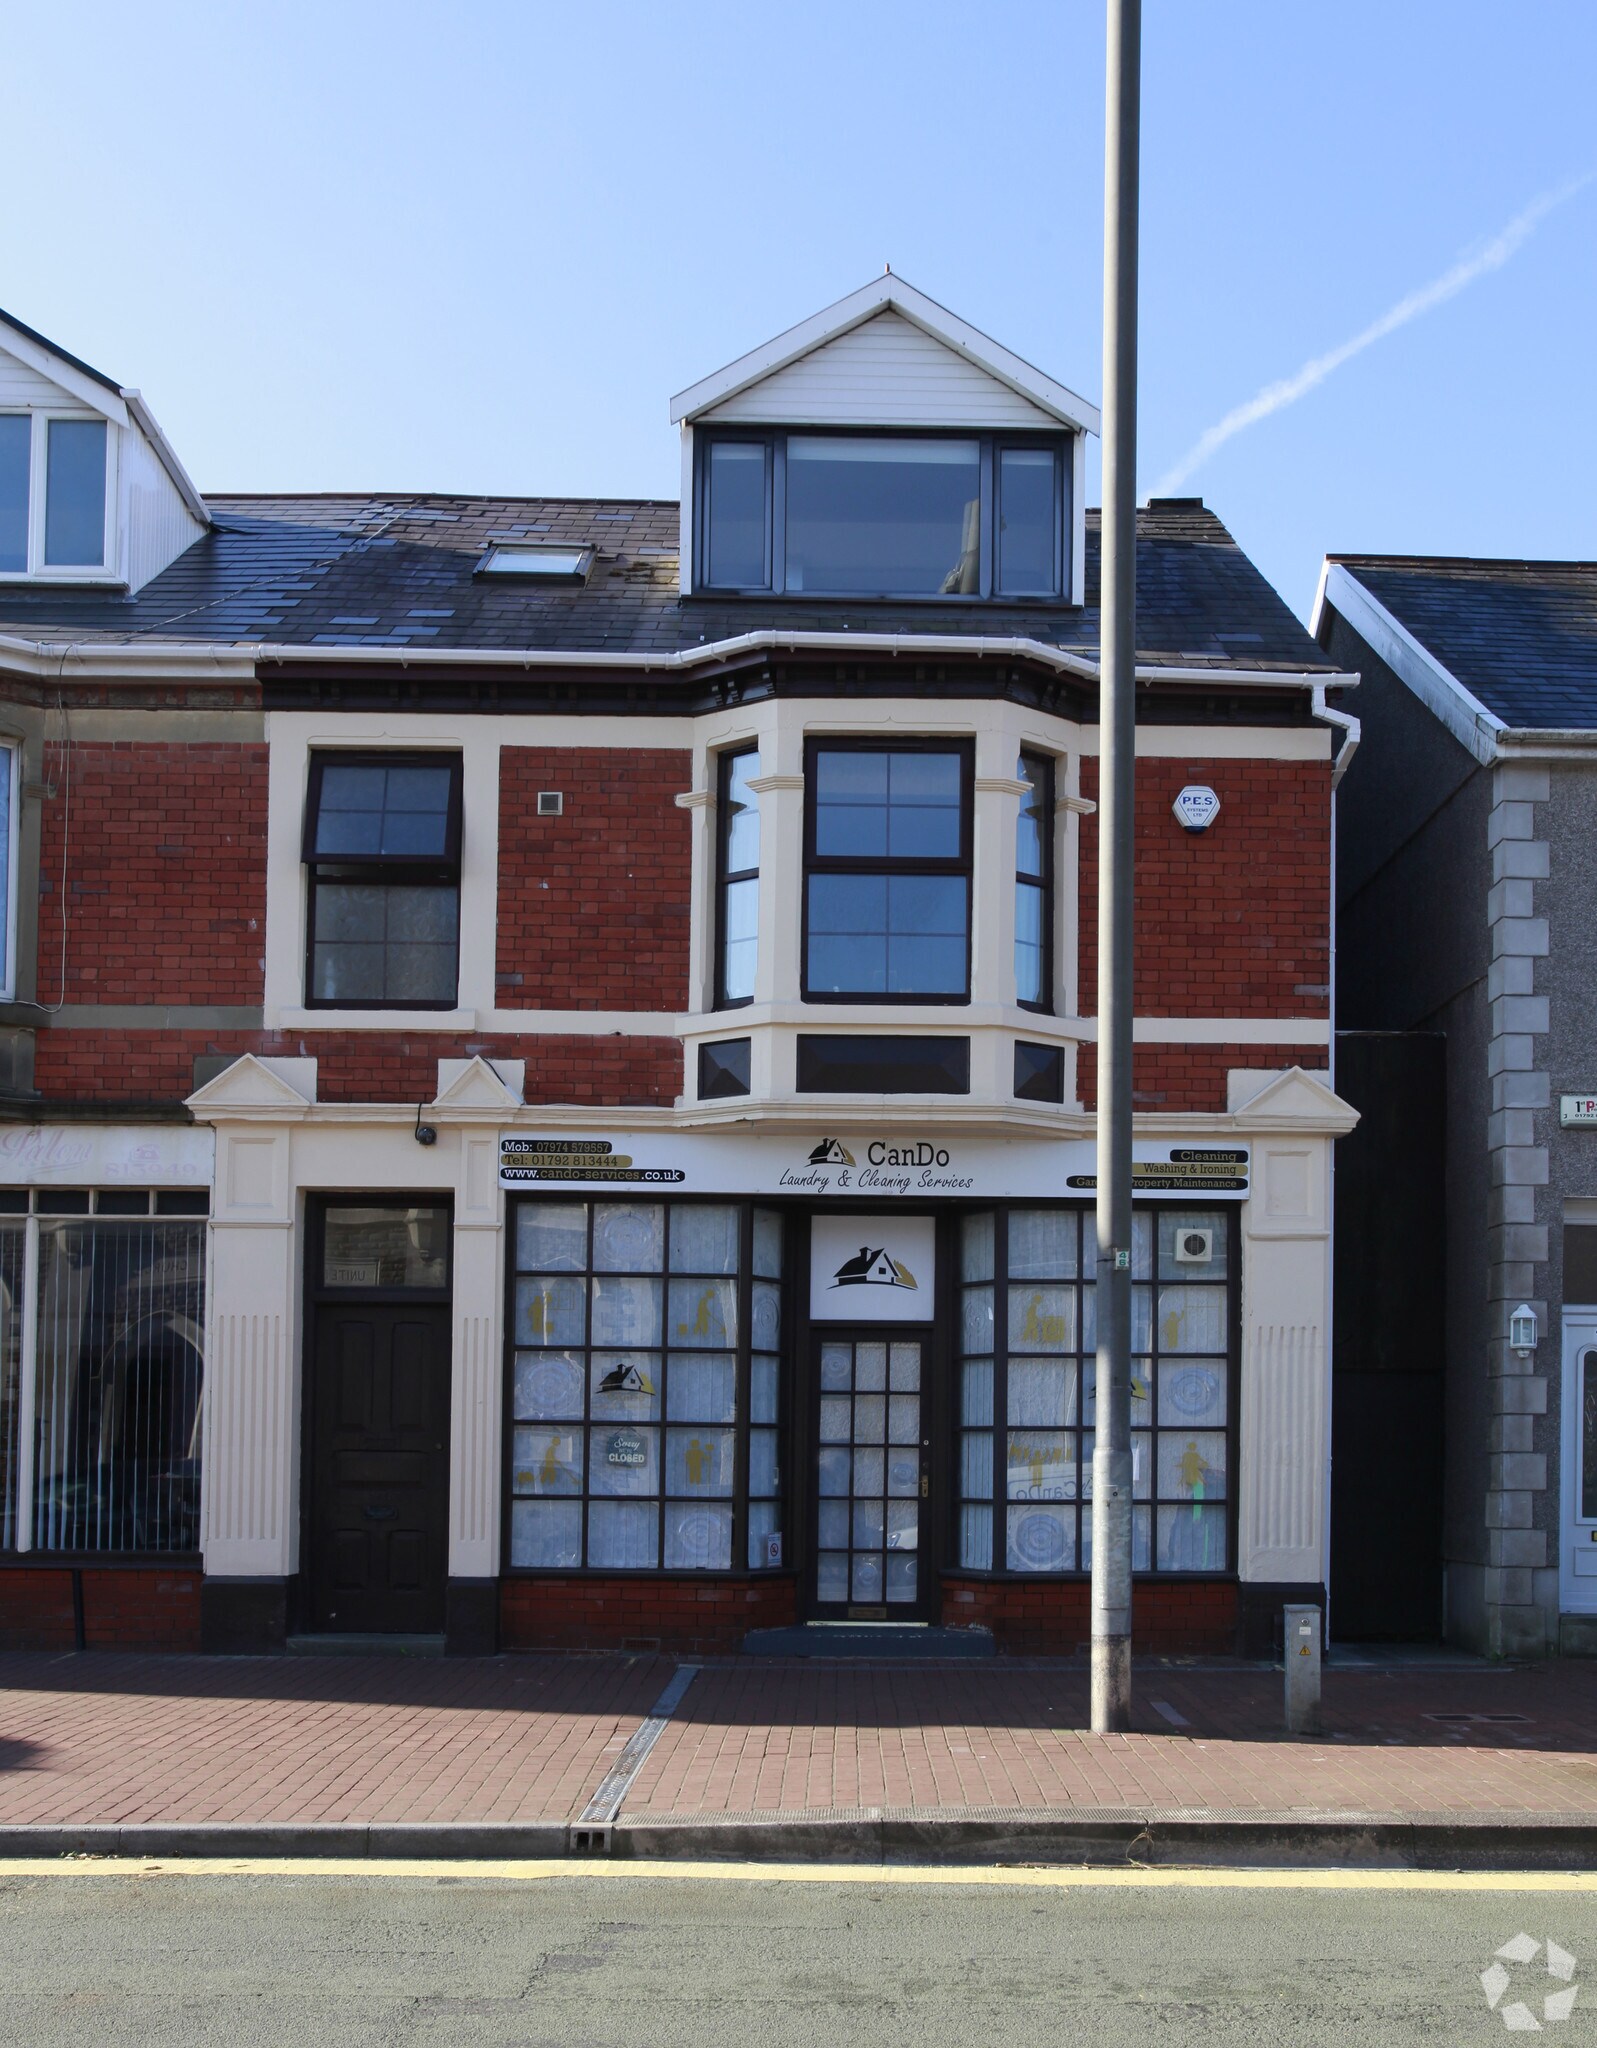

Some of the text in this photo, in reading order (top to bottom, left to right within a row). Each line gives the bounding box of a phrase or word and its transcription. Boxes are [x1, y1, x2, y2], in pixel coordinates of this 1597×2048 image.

[1183, 797, 1213, 805] P.E.S
[505, 1141, 610, 1153] Mob: 07974 579557
[505, 1155, 618, 1166] Tel: 01792 813444
[867, 1142, 950, 1167] CanDo
[1181, 1151, 1237, 1163] Cleaning
[504, 1167, 680, 1181] www.cando-services.co.uk
[1143, 1164, 1237, 1176] Washing & Ironing
[779, 1168, 974, 1193] Laundry & Cleaning Services
[1076, 1177, 1097, 1186] Gar
[1173, 1178, 1237, 1188] Maintenance
[614, 1438, 640, 1451] Sorry
[609, 1453, 644, 1463] CLOSED
